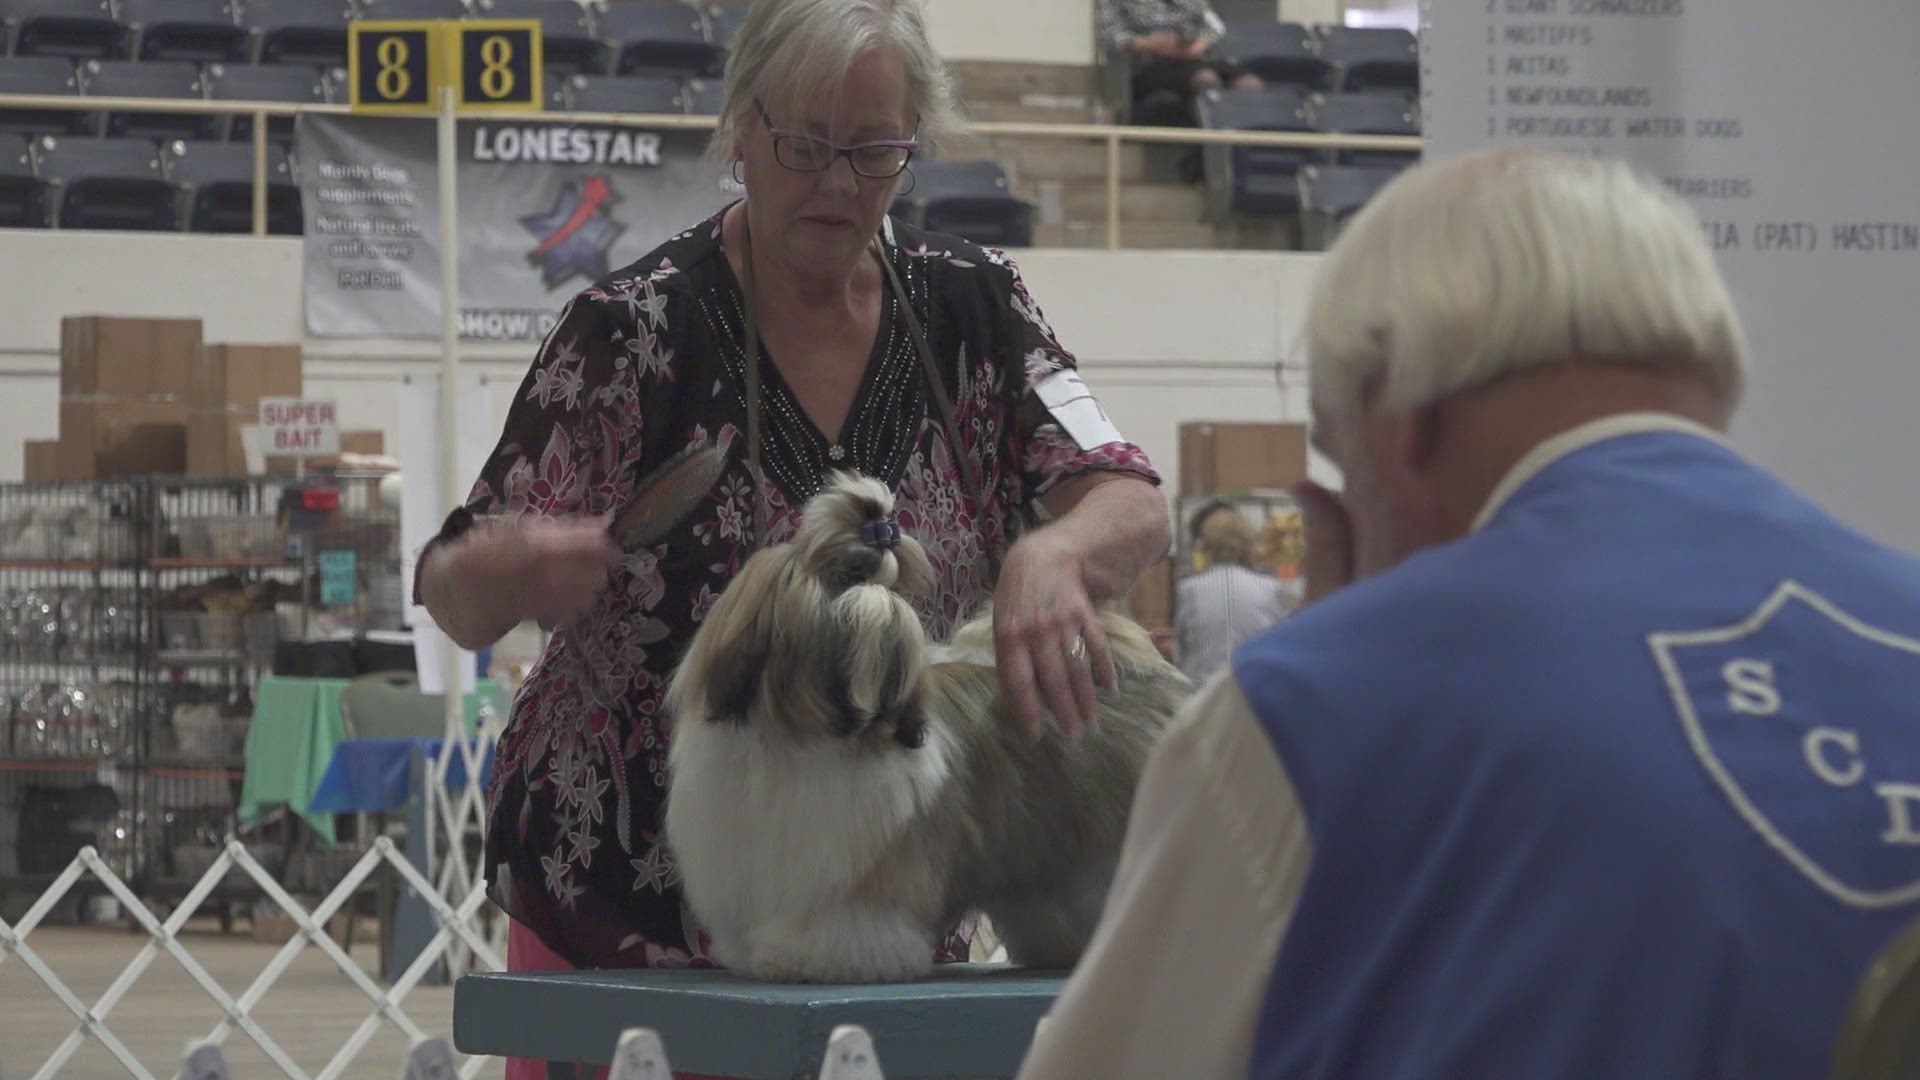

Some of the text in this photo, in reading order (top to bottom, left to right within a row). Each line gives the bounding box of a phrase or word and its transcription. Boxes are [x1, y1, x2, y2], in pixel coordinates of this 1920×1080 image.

[1487, 25, 1592, 45] 1 MASTIFFS
[376, 36, 411, 100] 8
[479, 35, 515, 99] 8
[1487, 56, 1569, 76] 1 AKITAS
[1488, 87, 1651, 106] 1 NEWFOUNDLANDS
[1488, 117, 1742, 138] 1 PORTUGUESE WATER DOGS
[473, 126, 662, 165] LONESTAR
[1754, 223, 1818, 253] (PAT)
[1832, 223, 1918, 251] HASTIN
[455, 313, 529, 337] SHOW
[264, 403, 336, 427] SUPER
[275, 427, 322, 449] BAIT
[1722, 658, 1781, 715] S
[1803, 727, 1865, 786] C
